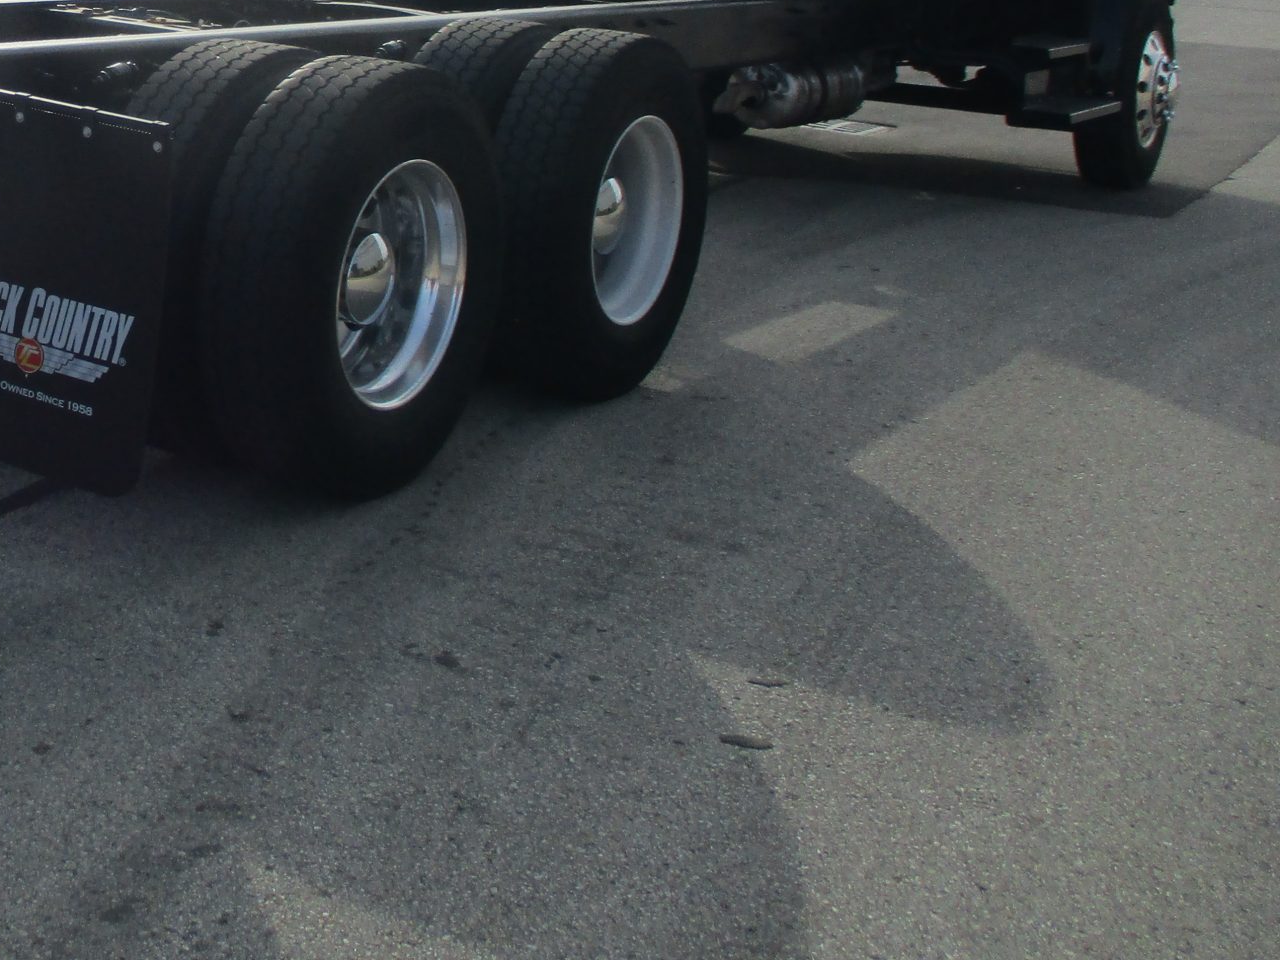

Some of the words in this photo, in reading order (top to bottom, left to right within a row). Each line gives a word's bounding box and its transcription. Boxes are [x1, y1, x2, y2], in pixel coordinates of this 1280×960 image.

[22, 287, 135, 365] COUNTRY
[0, 380, 35, 399] OWNED
[36, 391, 64, 408] SINCE
[67, 400, 93, 417] 1958
